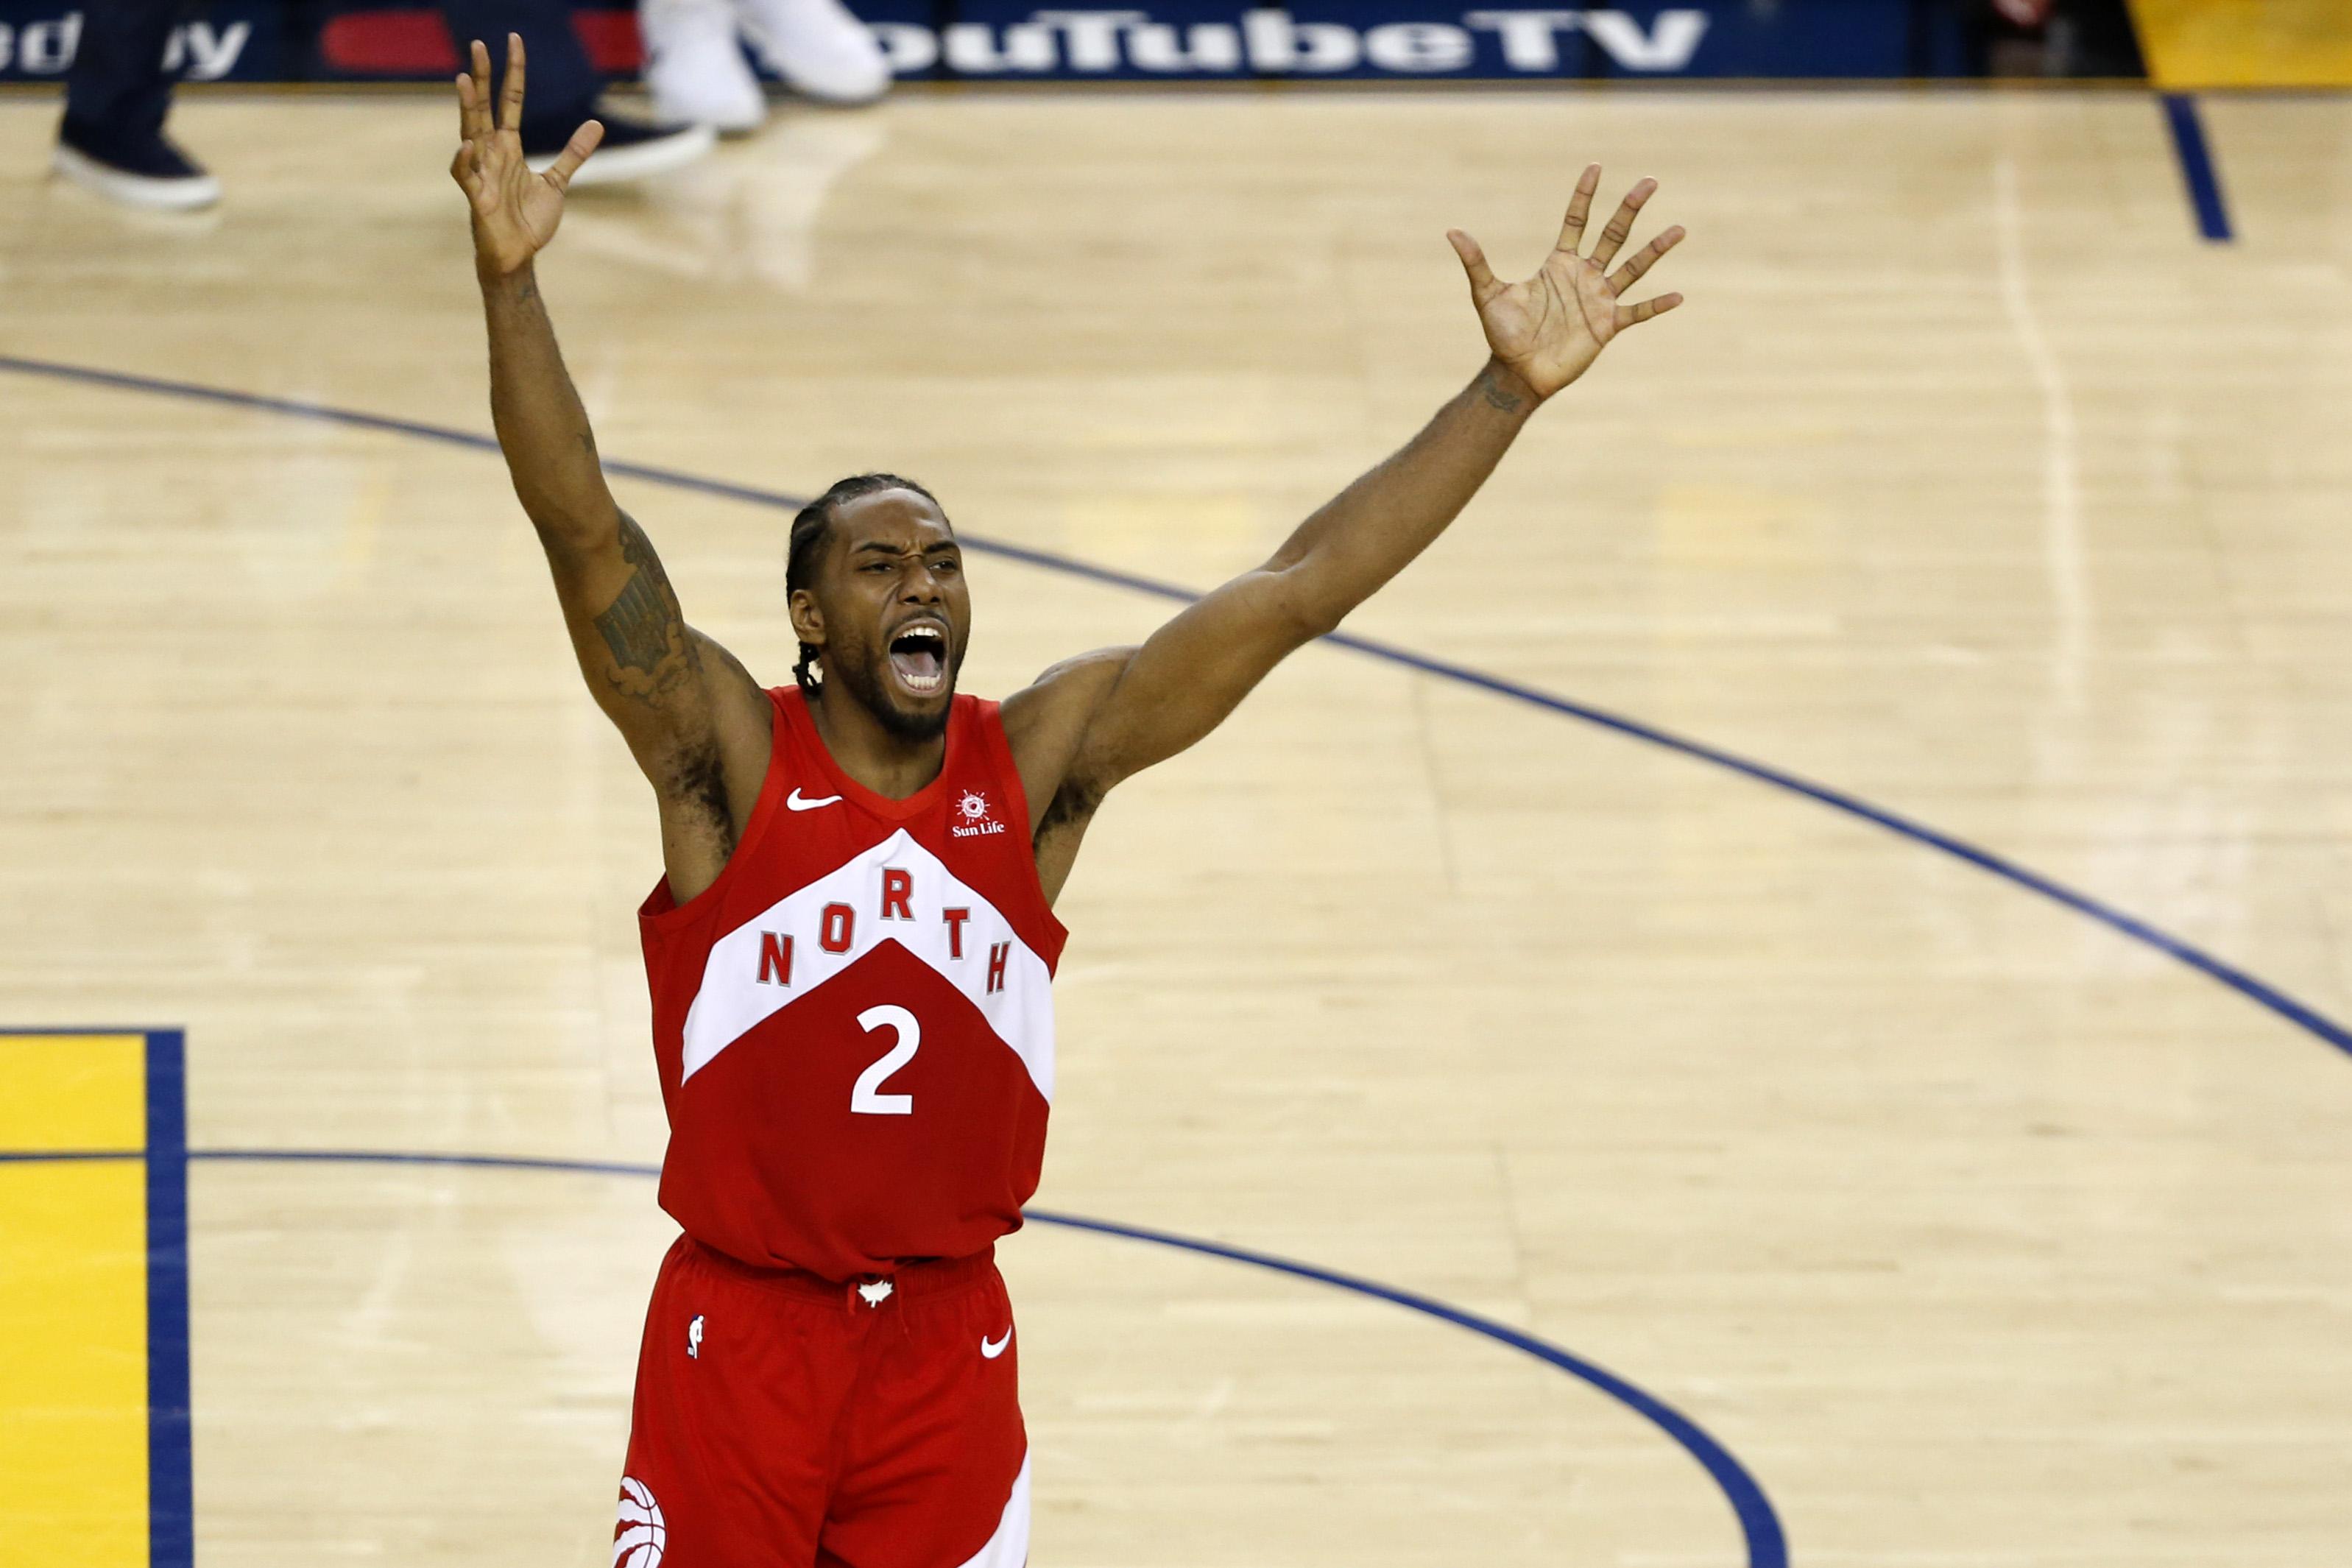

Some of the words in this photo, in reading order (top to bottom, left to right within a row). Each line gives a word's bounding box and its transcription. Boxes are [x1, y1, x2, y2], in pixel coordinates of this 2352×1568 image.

[0, 10, 84, 74] d
[952, 825, 980, 838] Sun
[979, 820, 1005, 835] Life
[756, 866, 1011, 995] NORTH
[850, 1004, 921, 1115] 2
